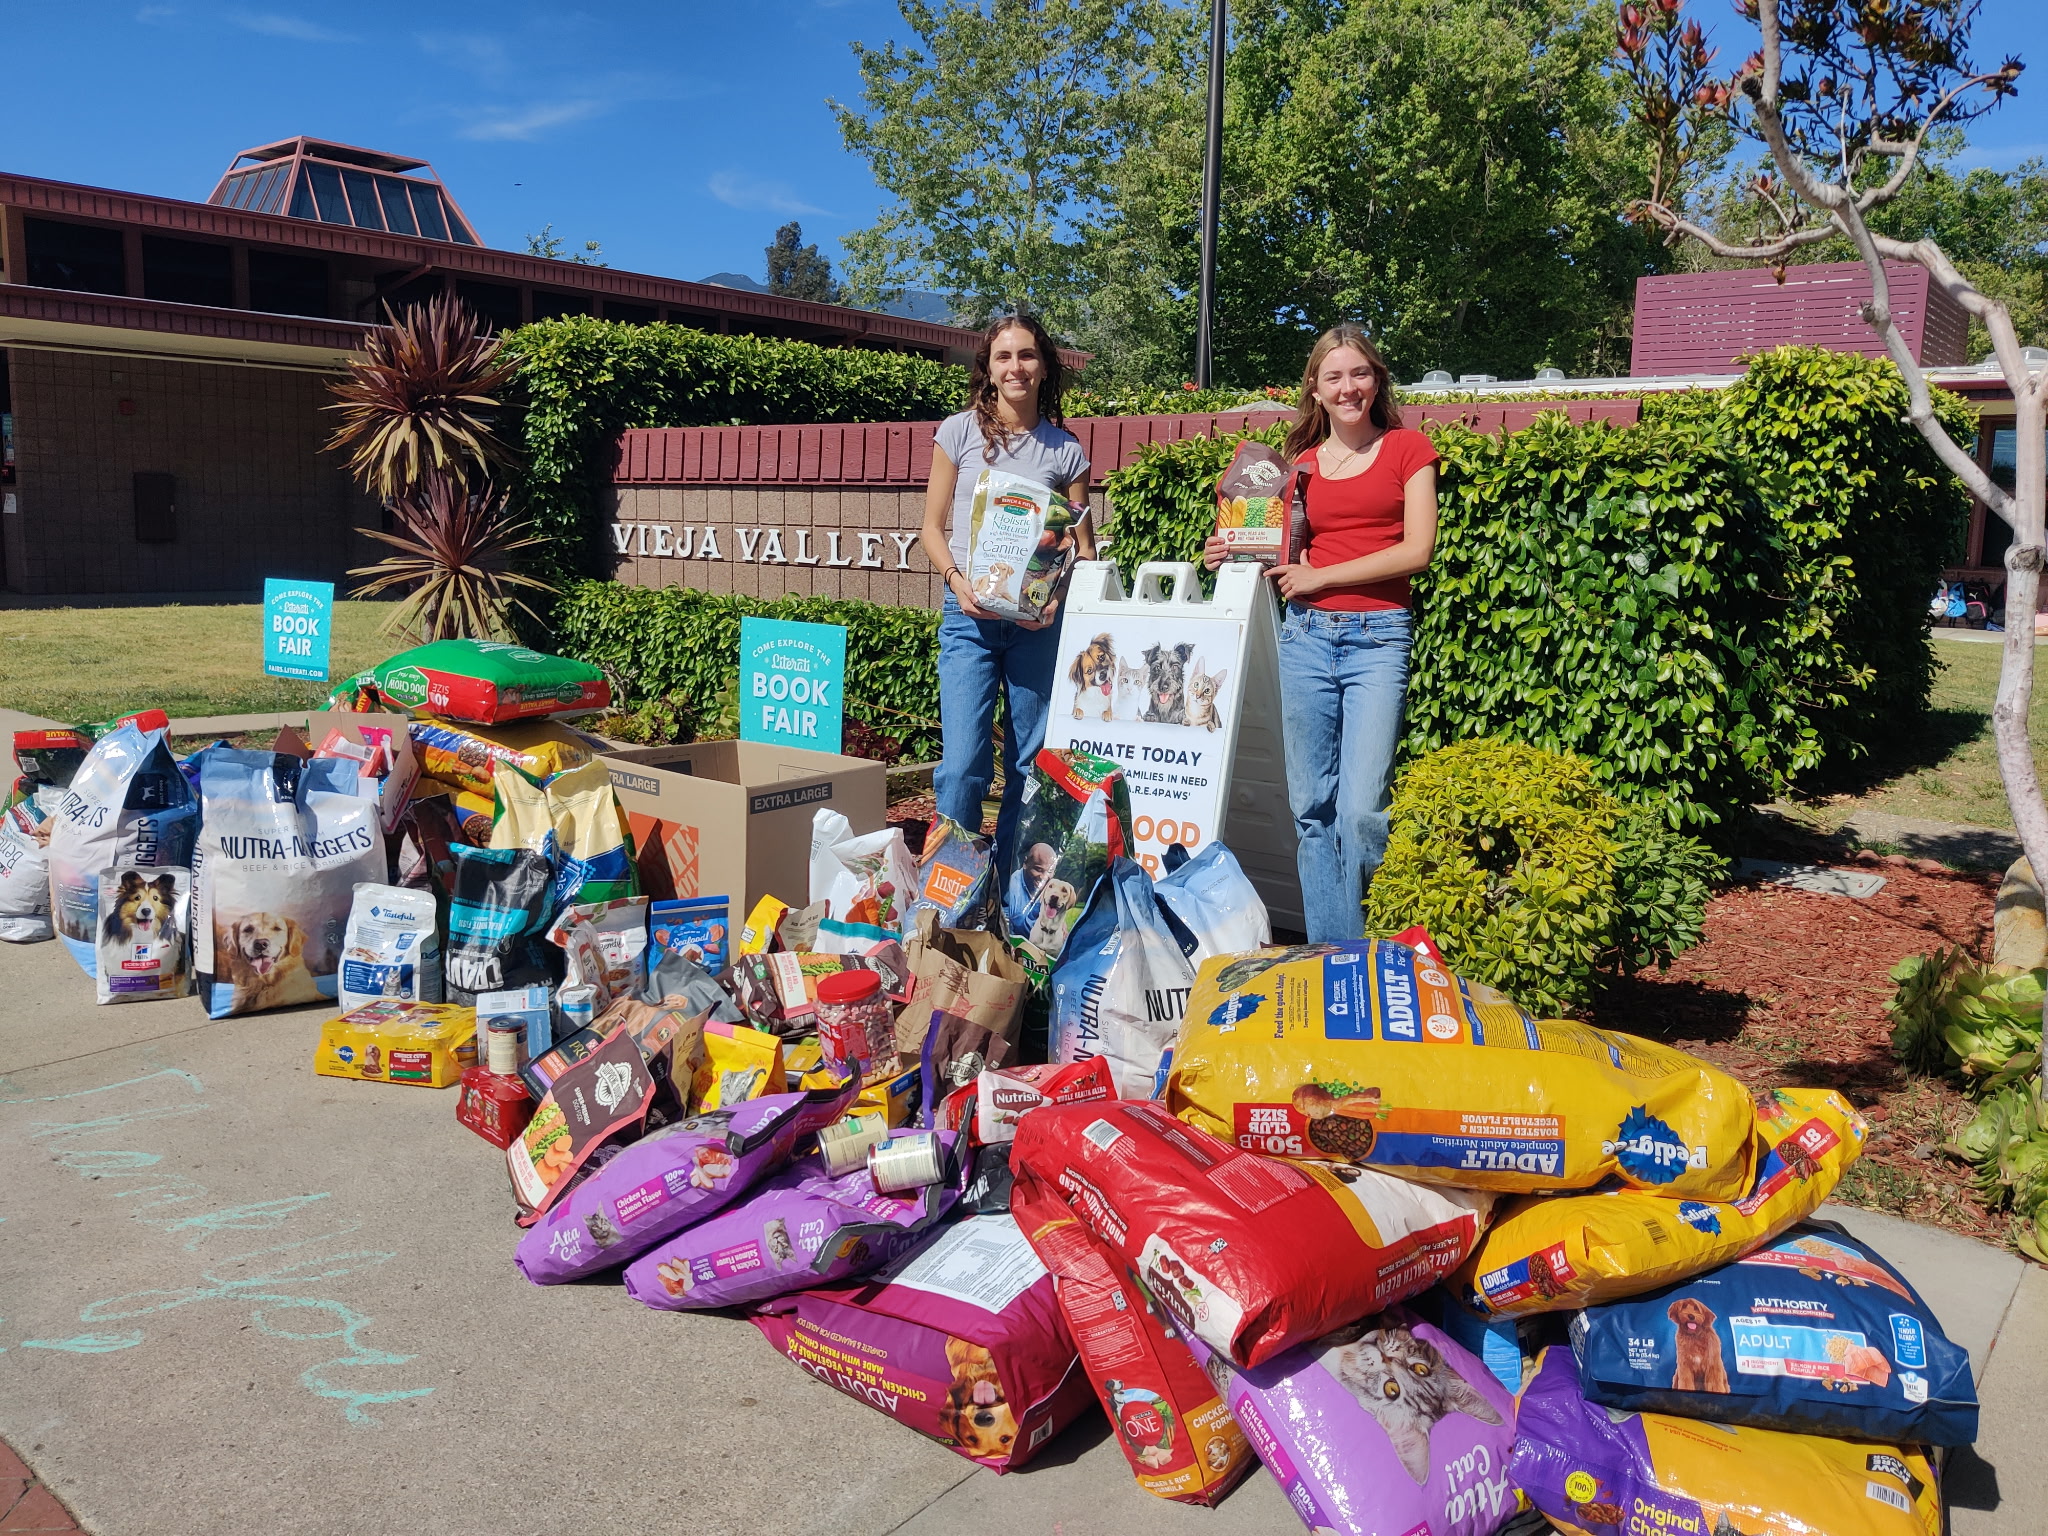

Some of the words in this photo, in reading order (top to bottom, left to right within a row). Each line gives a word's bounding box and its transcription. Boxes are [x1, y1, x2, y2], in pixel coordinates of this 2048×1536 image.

[992, 520, 1031, 535] Natural
[993, 512, 1031, 526] Holistic
[611, 523, 722, 559] VIEJA
[735, 528, 918, 569] VALLEY
[982, 540, 1029, 557] Canine
[271, 591, 287, 605] COME
[288, 590, 313, 601] EXPLORE
[313, 597, 325, 610] THE
[283, 601, 309, 615] Literati
[273, 614, 320, 637] BOOK
[278, 636, 312, 657] FAIR
[752, 640, 775, 658] COME
[777, 639, 814, 653] EXPLORE
[816, 648, 832, 666] THE
[268, 664, 323, 677] FAIRS.LITERATI.COM
[771, 653, 811, 673] Literati
[387, 678, 407, 692] CHOW
[407, 680, 425, 694] DOG
[432, 682, 449, 693] SIZE
[753, 671, 830, 707] BOOK
[520, 701, 537, 712] VALUE
[538, 699, 556, 709] SMART
[762, 705, 818, 738] FAIR
[46, 731, 70, 739] VALUE
[1070, 739, 1136, 759] DONATE
[1141, 746, 1202, 767] TODAY
[626, 776, 657, 793] LARGE
[1121, 768, 1164, 782] AMILIES
[1167, 774, 1178, 783] IN
[1180, 775, 1208, 787] NEED
[754, 791, 791, 811] EXTRA
[794, 785, 829, 803] LARGE
[258, 826, 290, 835] SUPER
[1133, 815, 1200, 848] OOD
[220, 825, 372, 860] NUTRA-NUGGETS
[242, 864, 268, 872] BEEF
[283, 861, 306, 872] RICE
[383, 907, 416, 921] Tastefuls
[671, 931, 709, 948] Seafood!
[1275, 991, 1286, 1007] good.
[1385, 969, 1415, 1038] ADULT
[1219, 991, 1243, 1036] Pedigree
[1274, 1006, 1284, 1019] the
[1101, 1020, 1110, 1054] SUPER
[1274, 1019, 1284, 1038] Feed
[996, 1091, 1041, 1104] Nutrish
[1057, 1092, 1074, 1103] WHOLE
[1074, 1089, 1092, 1100] HEALTH
[1092, 1085, 1107, 1096] BLEND
[1250, 1108, 1288, 1121] SIZE
[1461, 1114, 1501, 1125] FLAVOR
[1503, 1115, 1559, 1126] VEGETABLE
[1248, 1121, 1291, 1135] CLUB
[1459, 1124, 1467, 1133] &
[1469, 1125, 1512, 1136] CHICKEN
[1514, 1125, 1559, 1136] ROASTED
[1432, 1136, 1478, 1149] Nutrition
[1480, 1139, 1509, 1150] Adult
[1511, 1139, 1558, 1152] Complete
[1800, 1127, 1822, 1148] 18
[1601, 1135, 1708, 1169] Pedigree
[1461, 1149, 1559, 1174] ADULT
[664, 1168, 686, 1183] 100%
[1059, 1174, 1082, 1194] BLEND
[616, 1192, 641, 1209] Chicken
[641, 1187, 647, 1196] &
[619, 1201, 643, 1218] Salmon
[642, 1189, 662, 1204] Flavor
[1675, 1205, 1722, 1224] Pedigree
[800, 1219, 825, 1236] Cat!
[1101, 1214, 1126, 1247] WHOLE
[549, 1227, 581, 1255] Atta
[560, 1241, 582, 1261] Cat!
[735, 1249, 758, 1263] Salmon
[1429, 1247, 1461, 1268] WHOLE
[1784, 1254, 1808, 1262] RICE
[716, 1253, 736, 1267] Flavor
[736, 1259, 761, 1272] Chicken
[1551, 1250, 1566, 1270] 18
[1378, 1262, 1395, 1277] RECIPE
[1375, 1273, 1401, 1300] BLEND
[1482, 1269, 1509, 1290] ADULT
[1754, 1297, 1828, 1312] AUTHORITY
[805, 1322, 820, 1333] ADULT
[820, 1329, 831, 1338] FOR
[1898, 1327, 1916, 1335] TENDER
[794, 1330, 819, 1349] CHICKEN
[830, 1332, 857, 1349] BALANCED
[1628, 1337, 1640, 1347] 34
[1642, 1338, 1654, 1347] LB
[1739, 1334, 1792, 1349] ADULT
[799, 1345, 844, 1374] VEGETABLE
[820, 1346, 840, 1358] FRESH
[841, 1352, 861, 1366] WITH
[861, 1344, 888, 1359] COMPLETE
[845, 1366, 854, 1377] &
[862, 1360, 885, 1374] MADE
[1790, 1362, 1812, 1370] SALMON
[855, 1370, 877, 1386] RICE
[836, 1373, 899, 1412] ADULT
[878, 1376, 927, 1402] CHICKEN,
[1135, 1410, 1152, 1420] PURINA
[1192, 1403, 1230, 1429] CHICKEN
[1125, 1416, 1160, 1438] ONE
[1244, 1399, 1271, 1441] Chicken
[1268, 1441, 1278, 1453] &
[1239, 1406, 1265, 1445] Salmon
[1264, 1444, 1286, 1479] Flavor
[1444, 1443, 1491, 1494] Cat!
[1144, 1480, 1168, 1488] CHICKEN
[1174, 1473, 1191, 1484] RICE
[1154, 1485, 1184, 1493] FORMULA
[1294, 1481, 1316, 1515] 100%
[1445, 1464, 1509, 1526] Atta
[1634, 1497, 1700, 1534] Original
